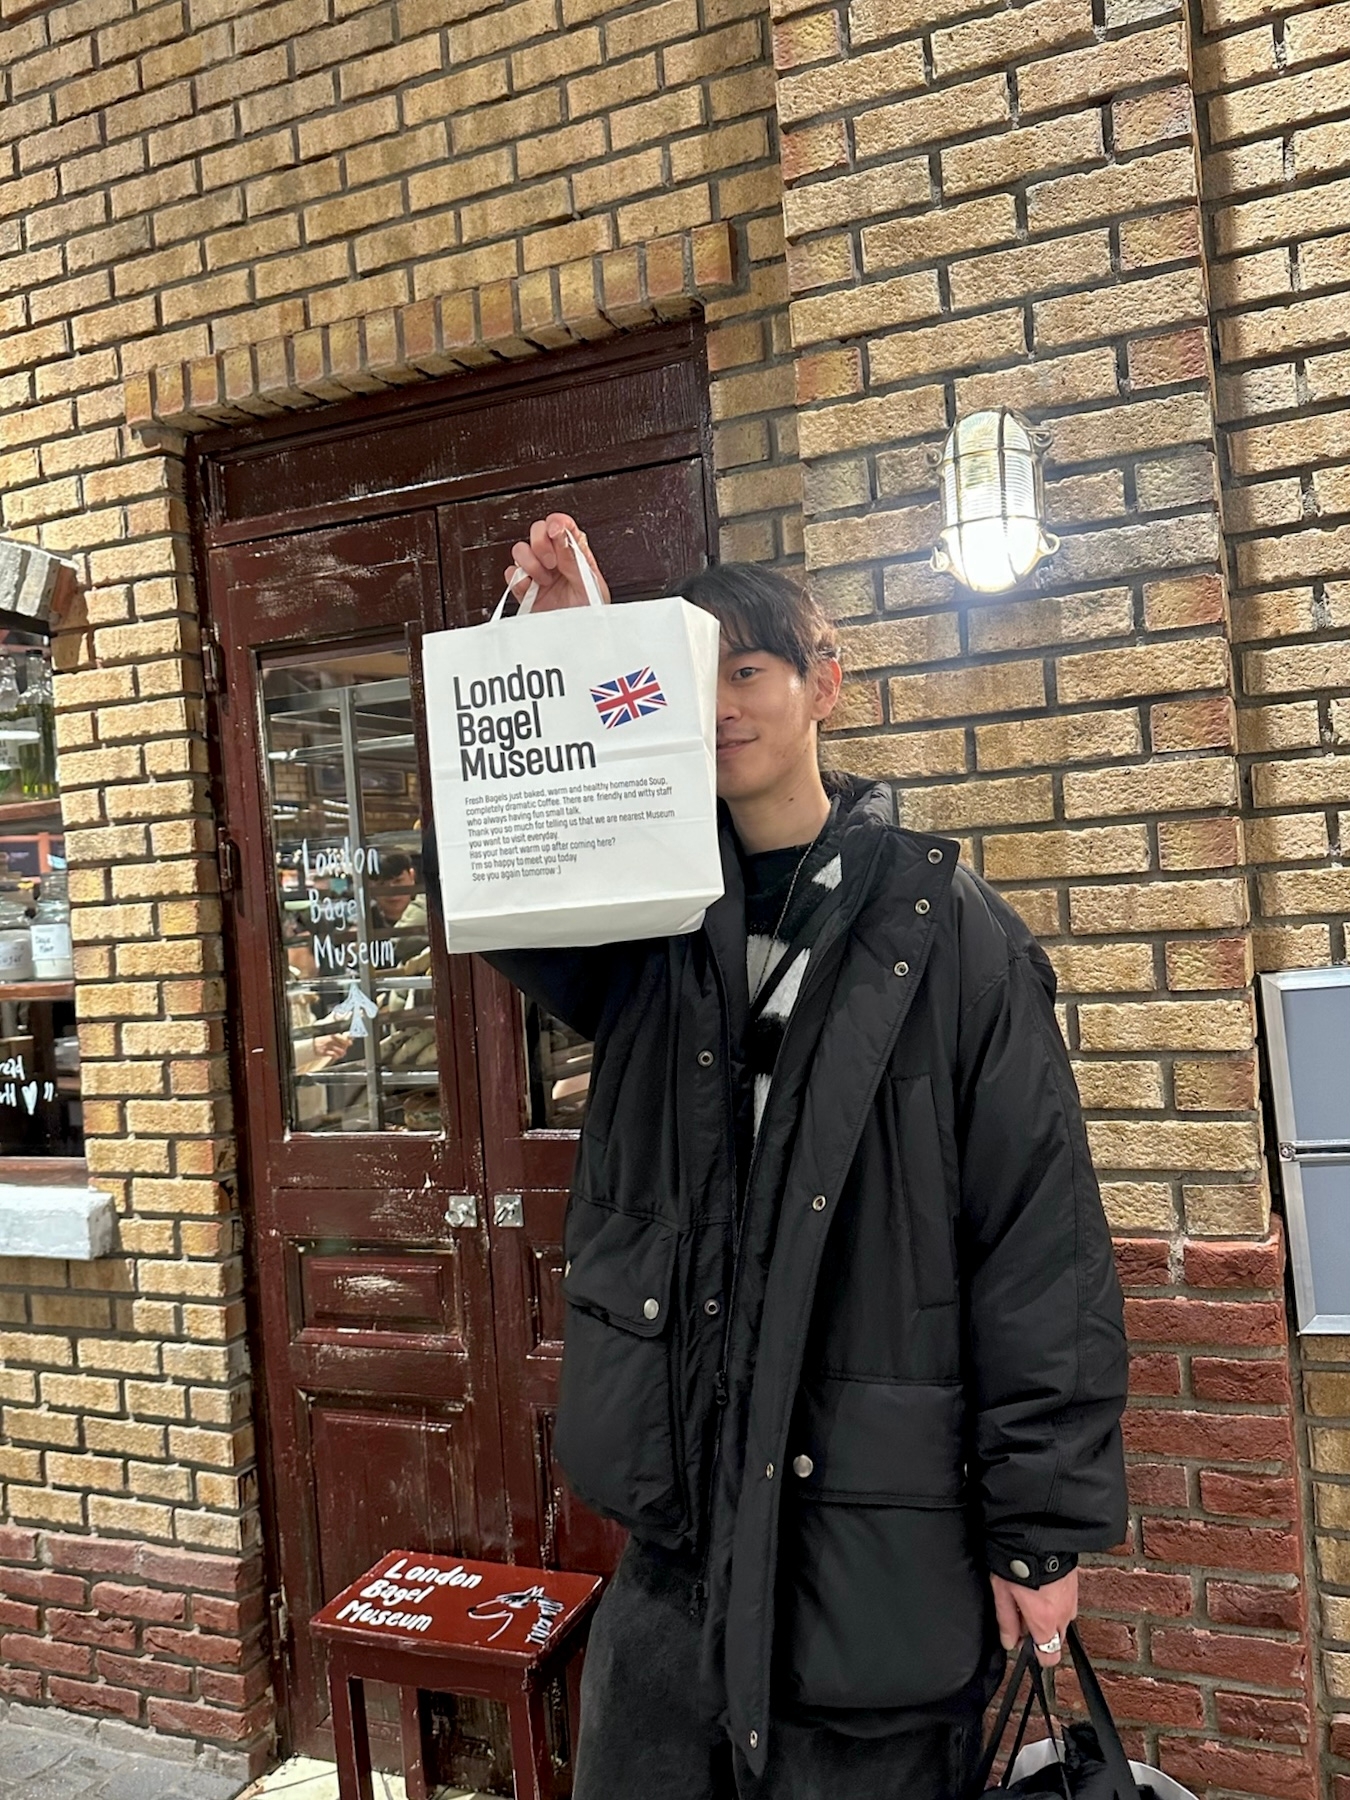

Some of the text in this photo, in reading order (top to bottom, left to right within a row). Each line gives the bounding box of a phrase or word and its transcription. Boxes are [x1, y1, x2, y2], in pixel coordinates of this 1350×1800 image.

[453, 664, 565, 710] London
[457, 701, 542, 751] Bagel
[460, 740, 597, 782] Museum
[465, 796, 484, 805] Fresh
[485, 793, 508, 803] Bagels
[509, 791, 522, 802] just
[569, 784, 582, 793] and
[583, 782, 608, 792] healthy
[610, 778, 648, 789] homemade
[466, 805, 504, 816] completely
[505, 800, 536, 811] dramatic
[562, 796, 582, 804] There
[597, 791, 622, 801] friendly
[624, 790, 636, 798] and
[638, 789, 655, 798] witty
[656, 786, 672, 796] staff
[467, 818, 482, 826] who
[483, 815, 507, 825] always
[508, 812, 532, 821] having
[532, 810, 544, 818] fun
[545, 808, 564, 817] small
[468, 828, 490, 837] Thank
[490, 827, 503, 836] you
[514, 822, 534, 831] much
[535, 821, 544, 829] for
[546, 819, 568, 828] telling
[569, 818, 578, 826] us
[578, 815, 594, 825] that
[595, 815, 605, 824] we
[606, 814, 618, 823] are
[619, 811, 645, 822] nearest
[646, 809, 675, 820] Museum
[302, 836, 380, 877] London
[469, 840, 482, 849] you
[483, 836, 501, 847] want
[502, 836, 510, 844] to
[511, 834, 526, 843] visit
[469, 837, 616, 859] Has your heart warm up after coming here?
[471, 862, 483, 870] I'm
[493, 859, 515, 868] happy
[516, 857, 524, 865] to
[524, 855, 543, 865] meet
[543, 855, 557, 865] you
[557, 853, 577, 862] today
[472, 872, 486, 882] See
[486, 872, 500, 881] you
[501, 870, 520, 880] again
[521, 868, 555, 877] tomorrow
[308, 887, 366, 931] Bagel
[313, 934, 395, 969] Museum
[383, 1558, 483, 1589] London
[360, 1578, 435, 1607] Bagel
[336, 1600, 433, 1632] Museum
